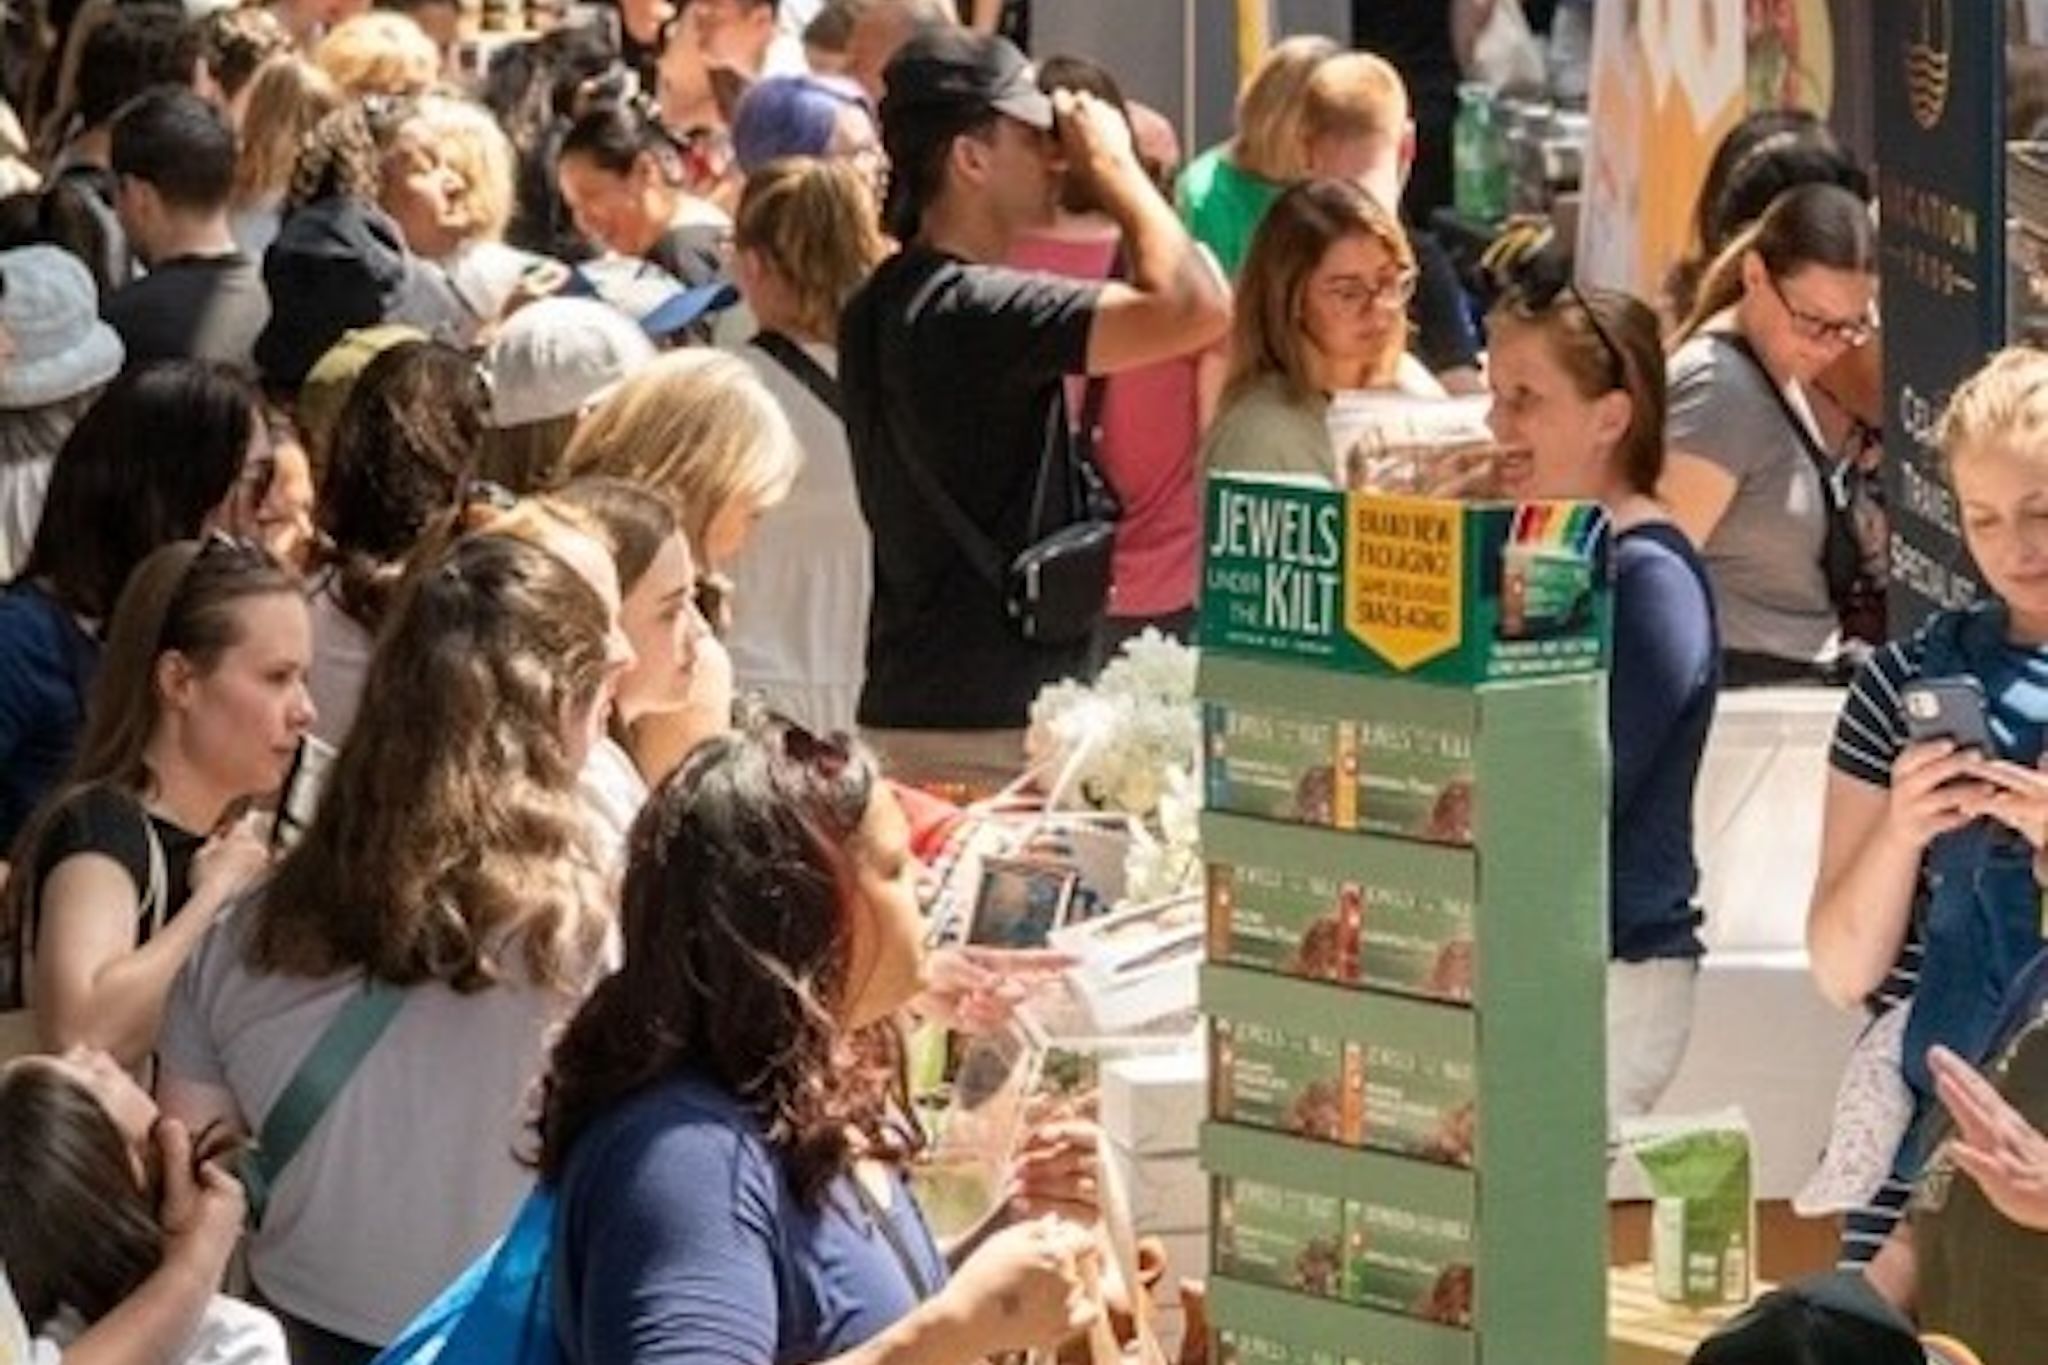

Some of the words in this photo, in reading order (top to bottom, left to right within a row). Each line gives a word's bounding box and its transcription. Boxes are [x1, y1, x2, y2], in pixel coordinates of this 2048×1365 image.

[1210, 488, 1338, 568] JEWELS
[1207, 568, 1262, 594] UNDER
[1265, 562, 1339, 636] KILT
[1229, 601, 1261, 628] THE
